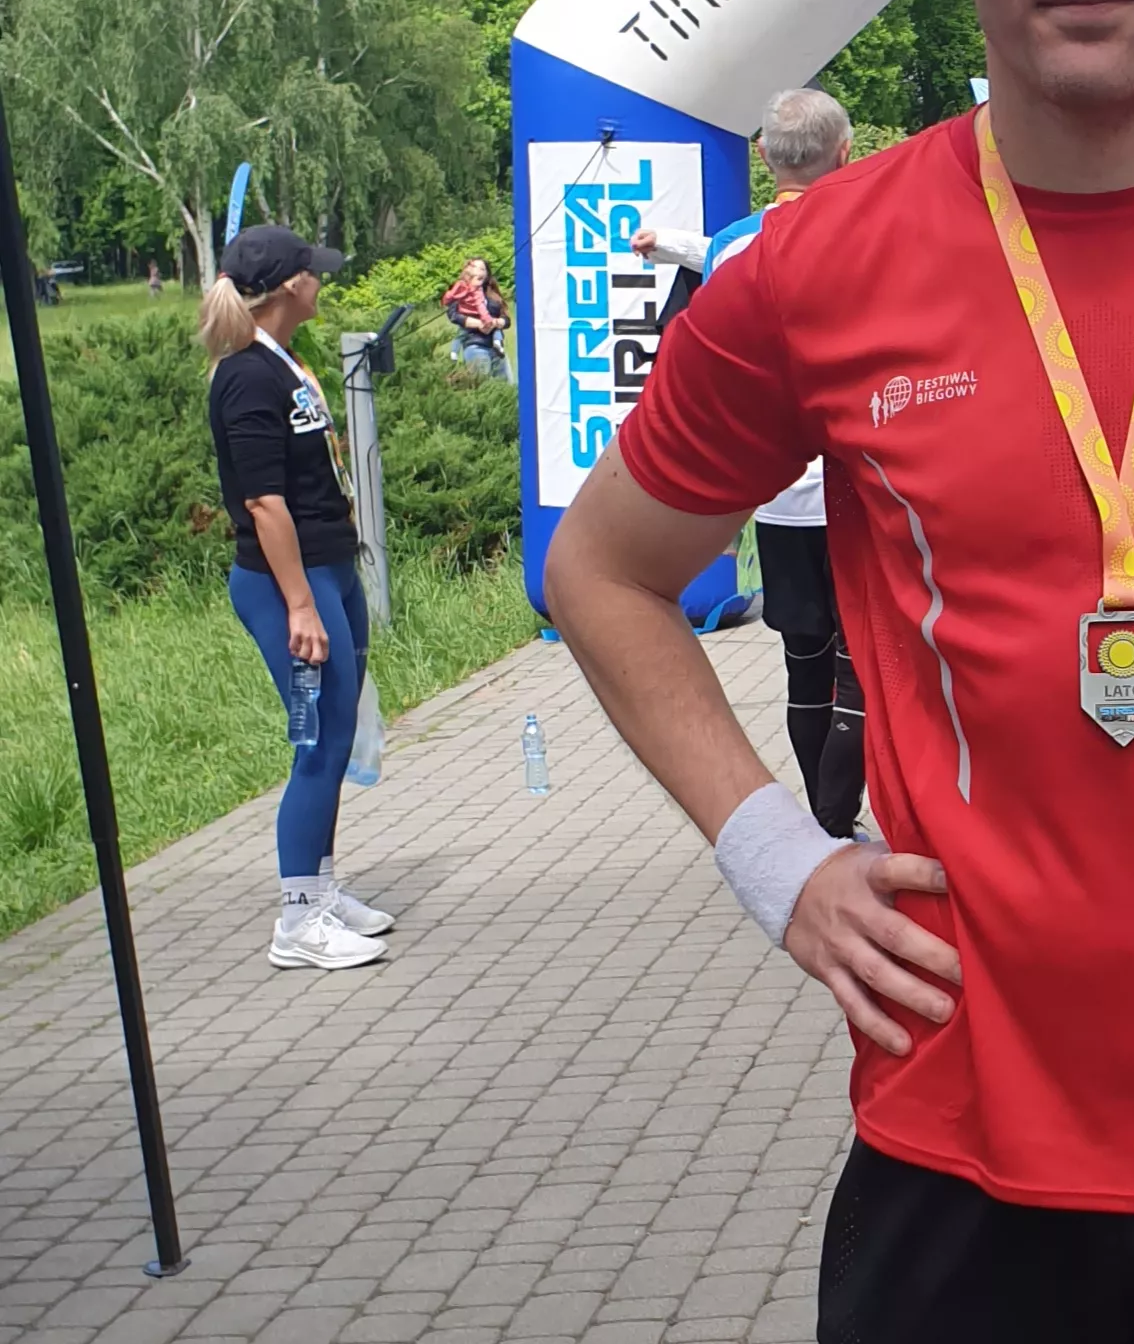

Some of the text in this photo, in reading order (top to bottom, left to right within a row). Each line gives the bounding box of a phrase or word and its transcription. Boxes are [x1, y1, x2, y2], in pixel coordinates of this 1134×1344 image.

[564, 183, 613, 469] STREFA
[916, 370, 979, 392] FESTIWAL
[916, 383, 977, 405] BIEGOWY
